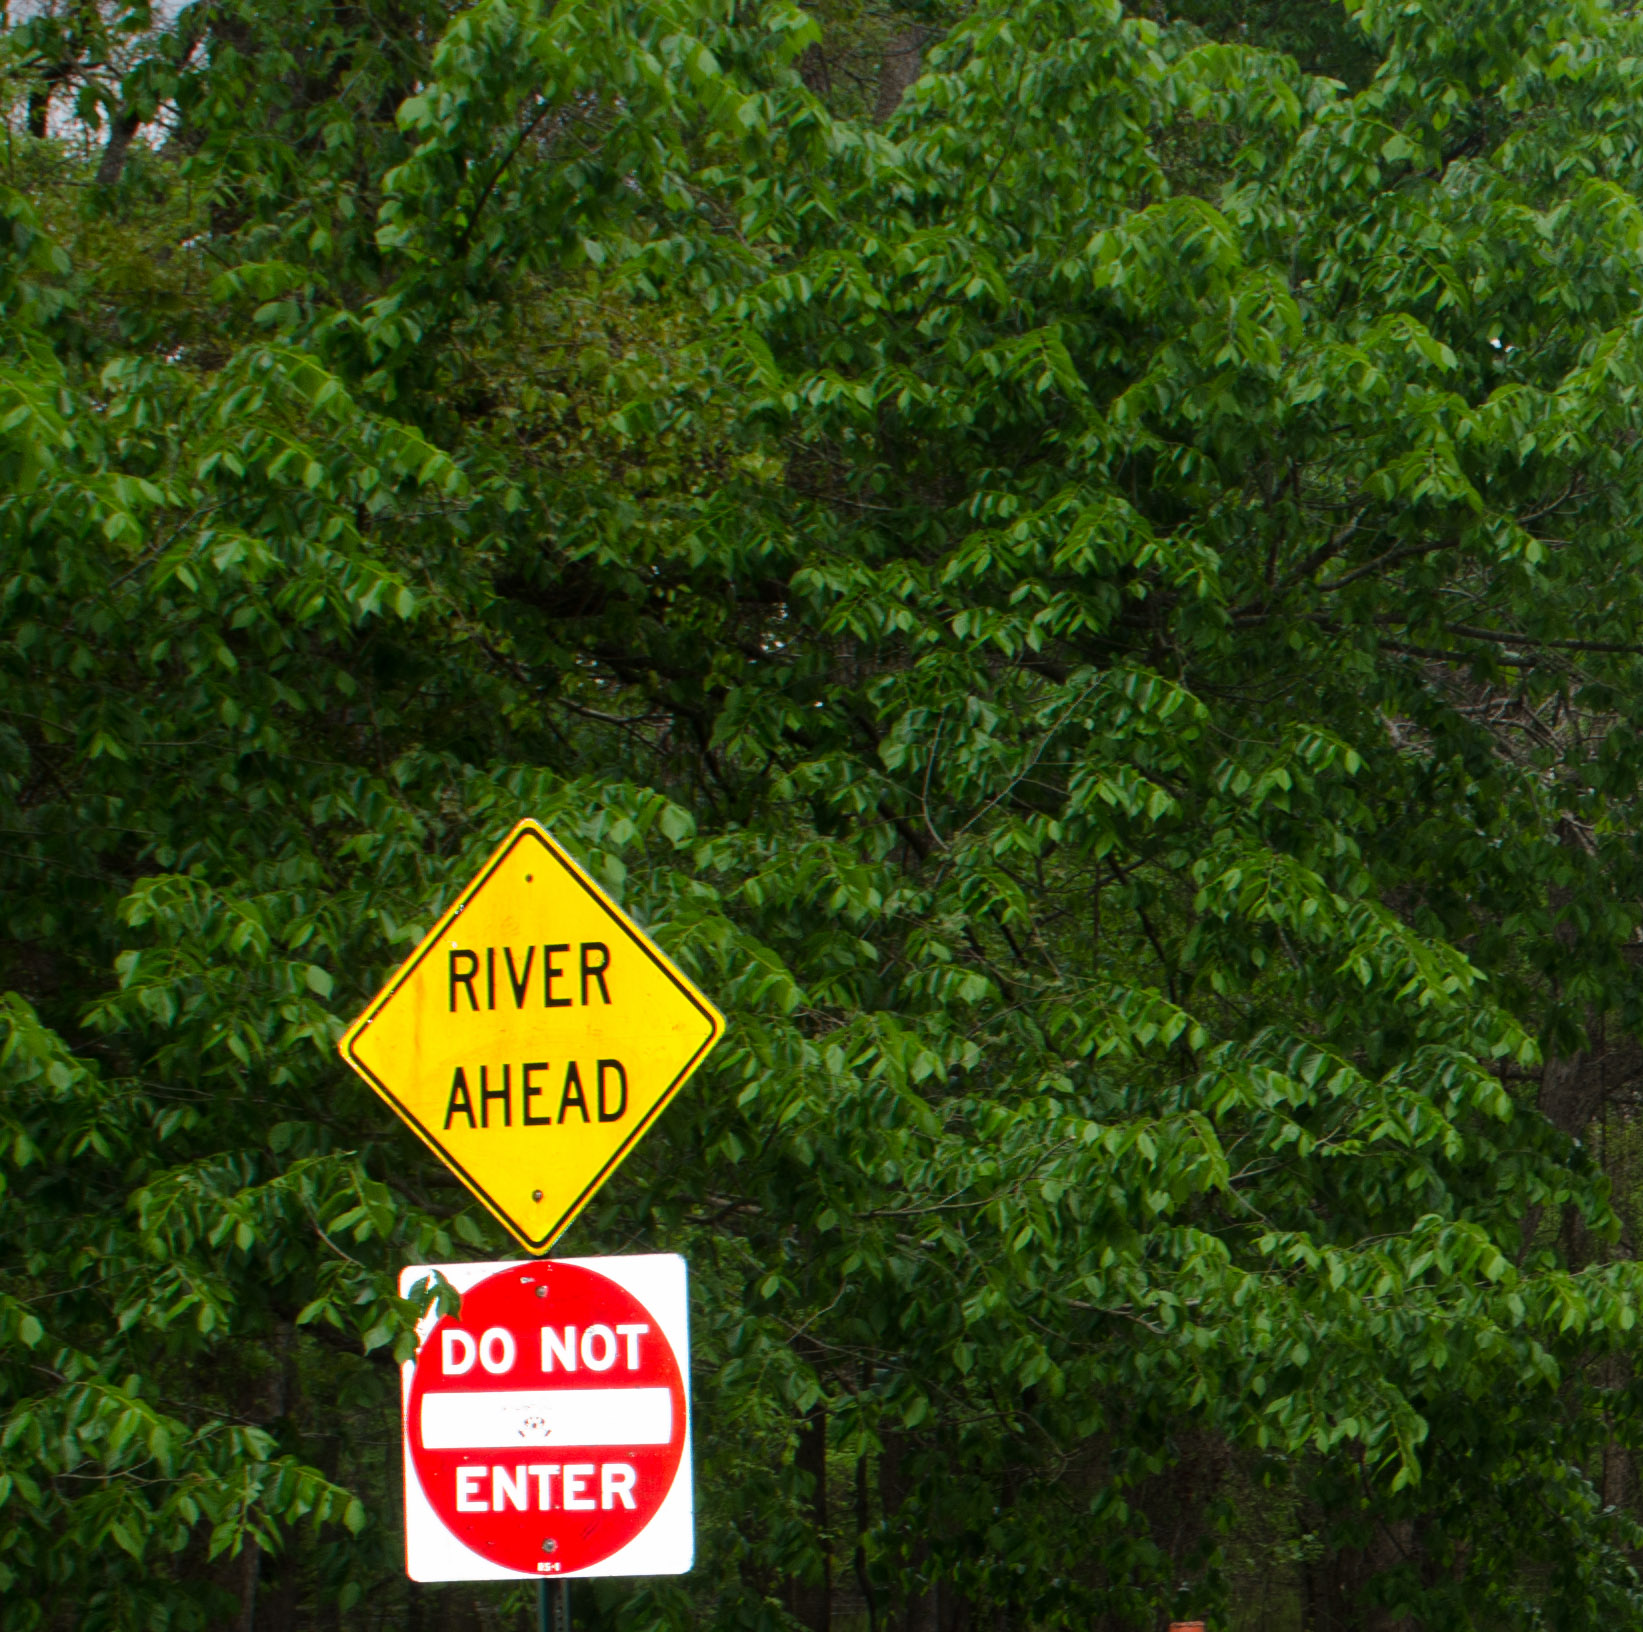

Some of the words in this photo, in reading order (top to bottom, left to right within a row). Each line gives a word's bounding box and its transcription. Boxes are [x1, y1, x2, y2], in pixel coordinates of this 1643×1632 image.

[448, 941, 612, 1013] RIVER
[443, 1058, 629, 1131] AHEAD
[441, 1328, 515, 1376] DO
[540, 1323, 650, 1372] NOT
[455, 1462, 638, 1514] ENTER
